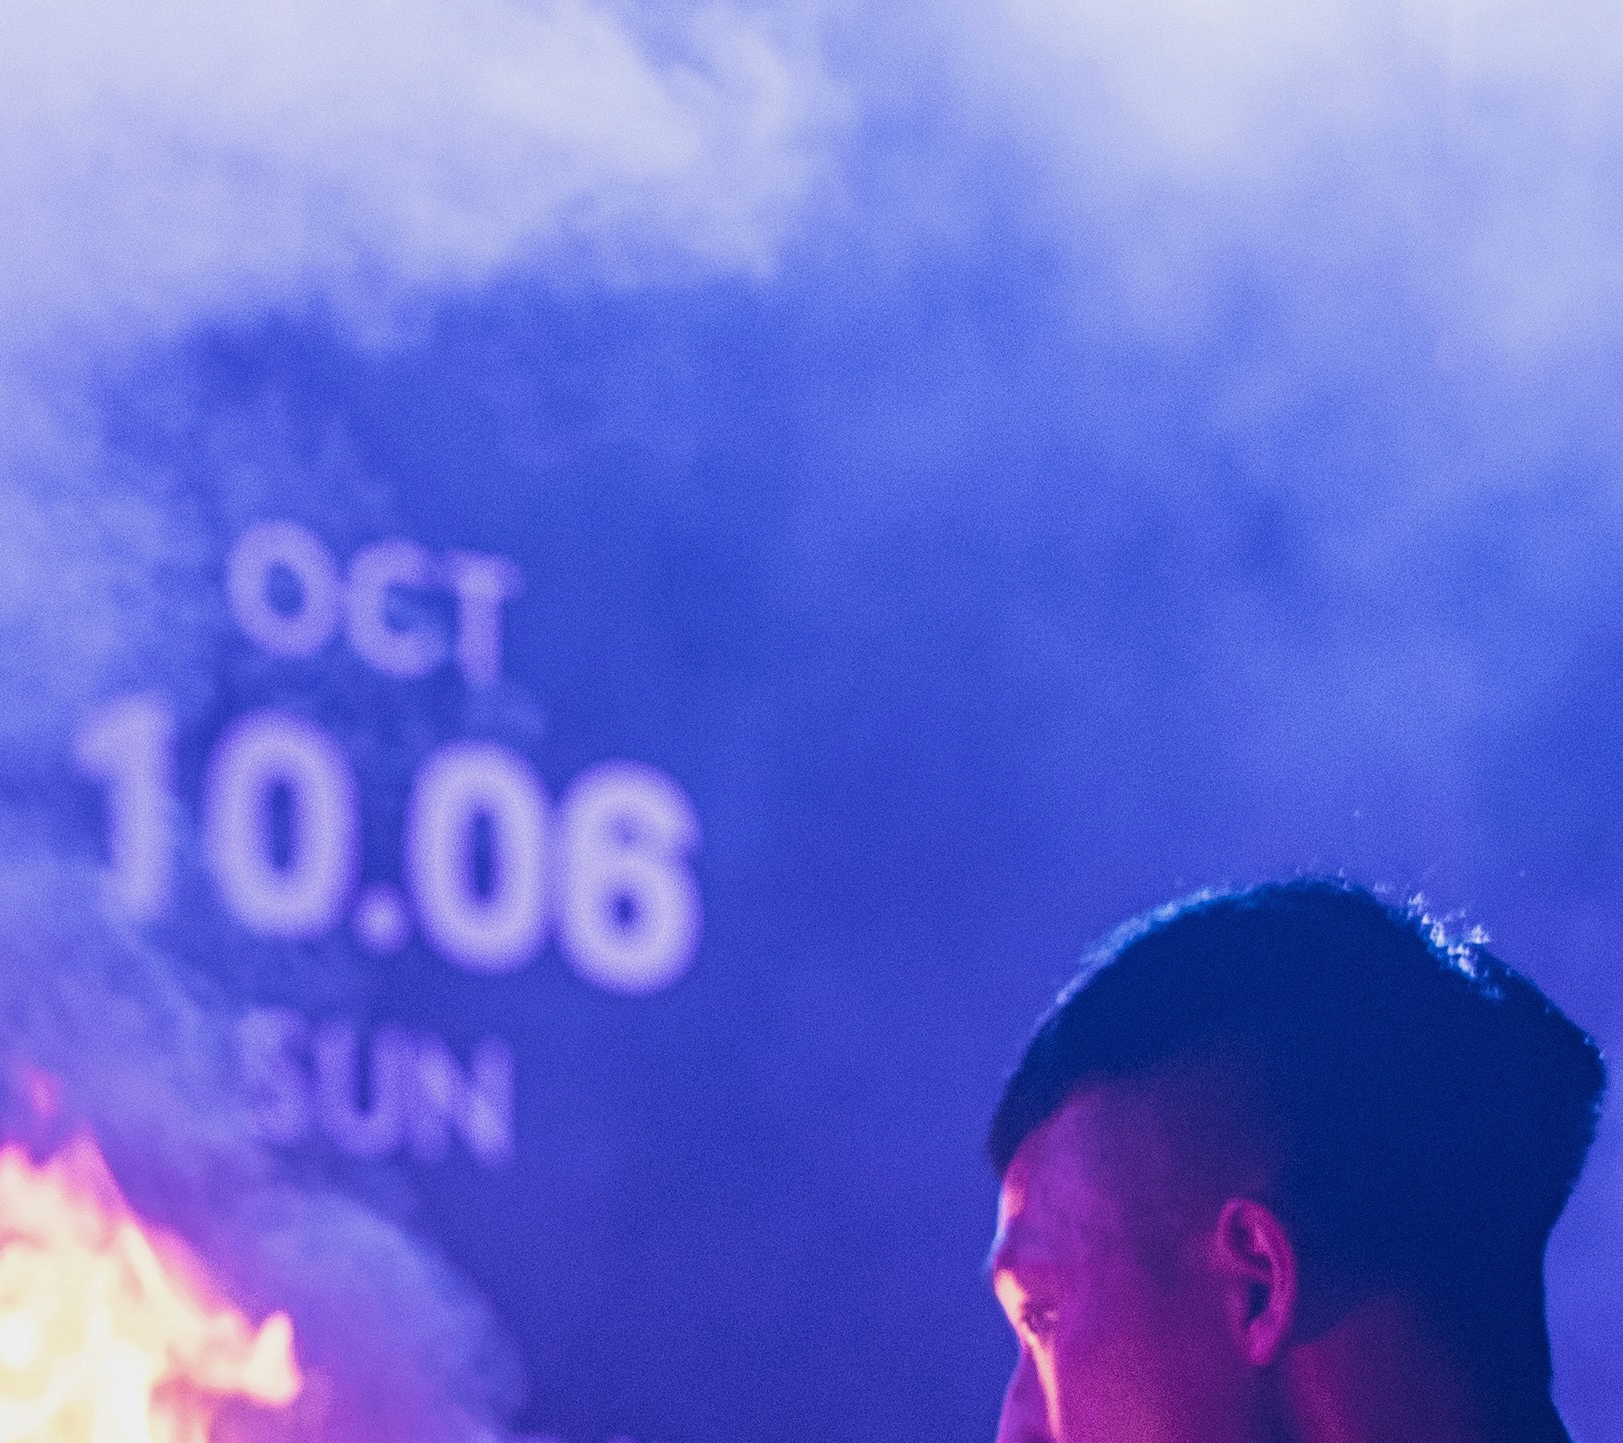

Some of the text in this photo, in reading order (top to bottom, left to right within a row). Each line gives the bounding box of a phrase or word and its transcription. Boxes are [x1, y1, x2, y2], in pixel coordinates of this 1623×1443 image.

[227, 520, 518, 690] OCT
[80, 698, 703, 994] 10.06
[238, 1008, 518, 1168] SUN
